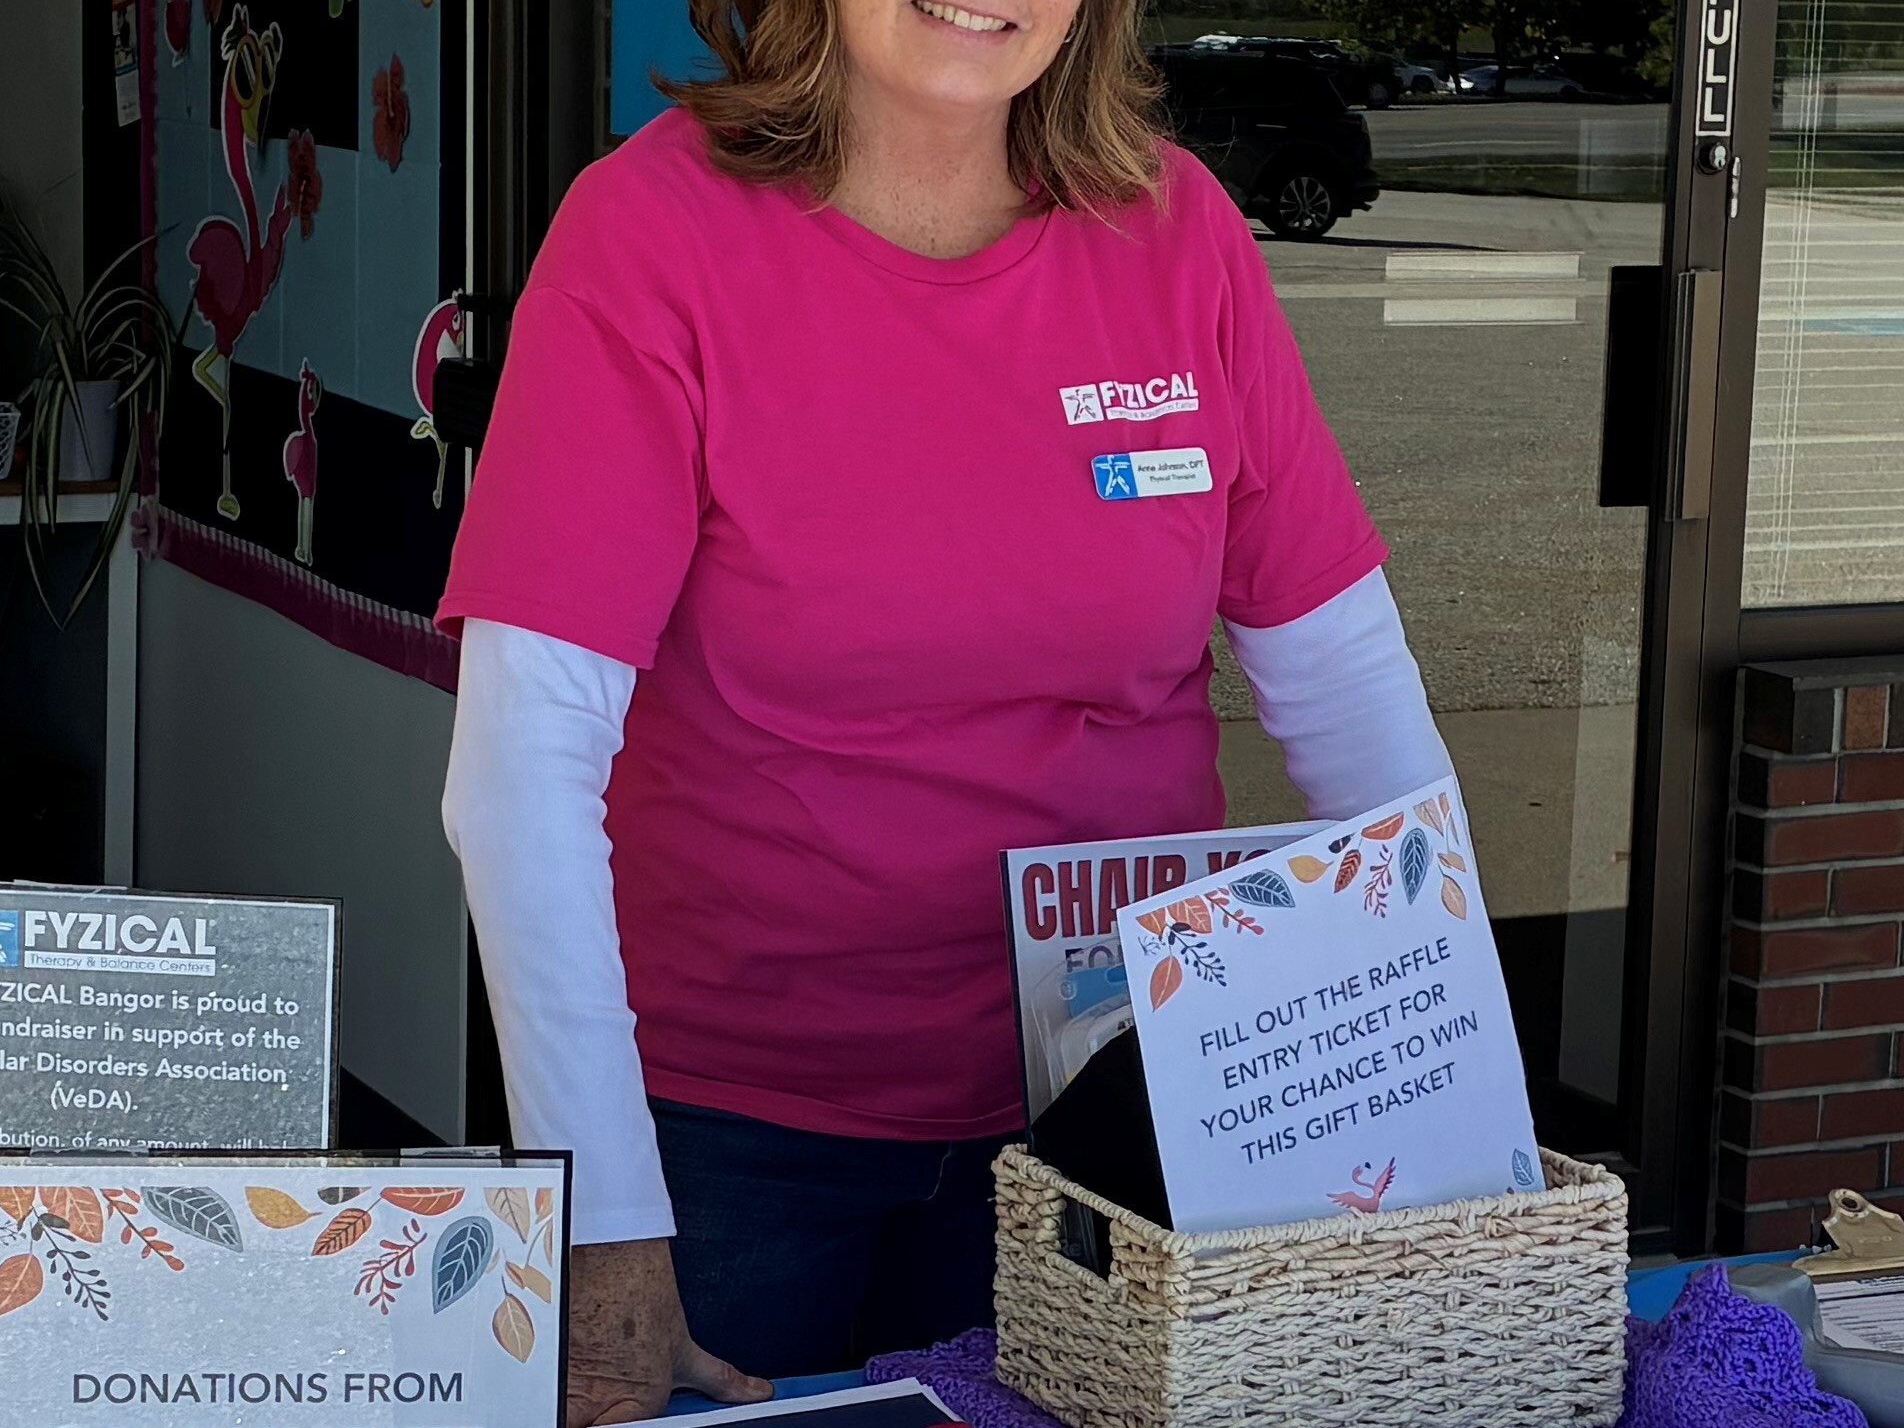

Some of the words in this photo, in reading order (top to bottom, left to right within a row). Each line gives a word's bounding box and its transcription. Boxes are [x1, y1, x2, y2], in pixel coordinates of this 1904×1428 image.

[24, 910, 216, 955] FYZICAL
[29, 953, 83, 969] Therapy
[85, 954, 96, 968] &
[99, 956, 156, 971] Balance
[159, 958, 211, 973] Centers
[1065, 945, 1121, 973] FO
[79, 985, 164, 1013] Bangor
[172, 989, 190, 1011] is
[197, 991, 268, 1017] proud
[274, 995, 300, 1016] to
[1200, 1018, 1251, 1058] FILL
[1255, 996, 1309, 1036] OUT
[1313, 974, 1365, 1013] THE
[1370, 937, 1452, 998] RAFFLE
[104, 1022, 125, 1043] in
[131, 1024, 225, 1051] support
[230, 1027, 257, 1048] of
[262, 1028, 302, 1050] the
[1222, 1042, 1304, 1091] ENTRY
[1308, 1012, 1394, 1058] TICKET
[1400, 983, 1448, 1026] FOR
[36, 1052, 149, 1077] Disorders
[154, 1057, 289, 1085] Association
[1200, 1096, 1275, 1140] YOUR
[1280, 1056, 1389, 1109] CHANCE
[1392, 1039, 1426, 1072] TO
[1430, 1011, 1480, 1053] WIN
[50, 1081, 139, 1113] (VeDA).
[1240, 1125, 1298, 1166] THIS
[1304, 1103, 1360, 1144] GIFT
[1370, 1062, 1457, 1119] BASKET
[71, 1130, 93, 1148] of
[72, 1372, 328, 1405] DONATIONS
[343, 1372, 465, 1404] FROM
